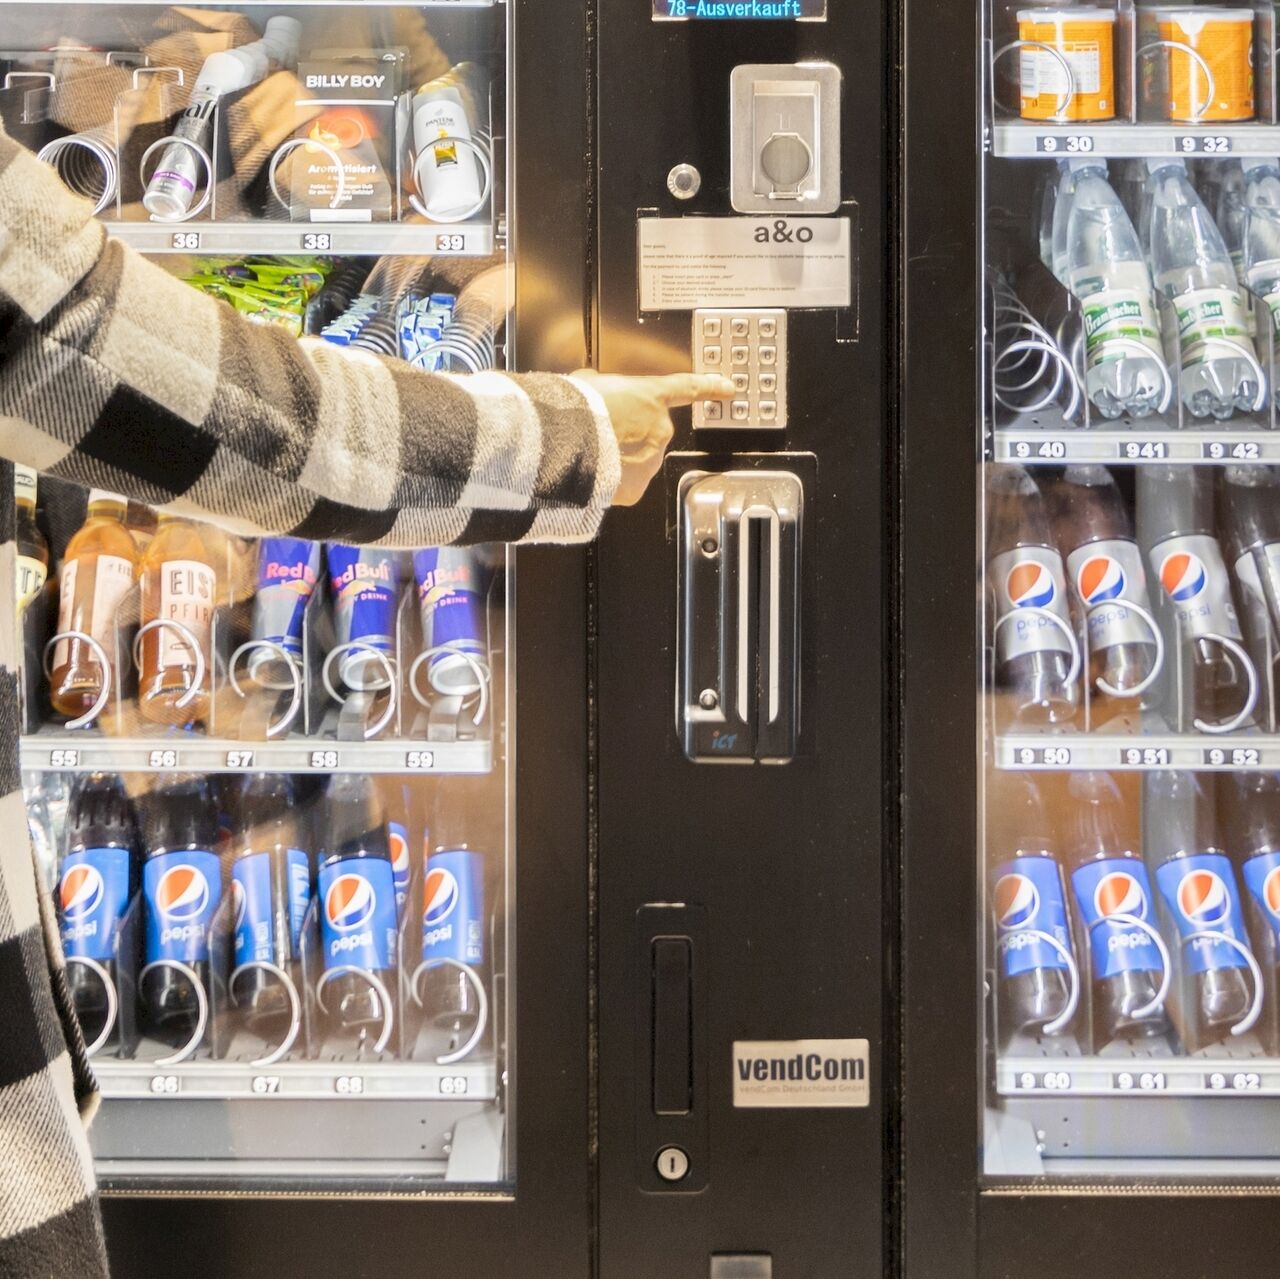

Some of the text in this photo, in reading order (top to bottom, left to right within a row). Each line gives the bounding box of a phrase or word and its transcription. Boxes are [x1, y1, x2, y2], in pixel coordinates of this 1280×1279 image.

[668, 0, 801, 16] 78-Ausverkauft
[306, 75, 385, 88] BILLY BOY
[308, 164, 377, 174] Aromtisiert
[754, 220, 813, 243] a&o
[173, 234, 198, 249] 36
[304, 234, 330, 250] 38
[438, 235, 464, 250] 39
[266, 562, 302, 579] Red
[355, 561, 390, 581] Bull
[1178, 604, 1210, 621] epsi
[1016, 615, 1058, 633] peps
[52, 752, 77, 766] 55
[150, 752, 176, 766] 56
[228, 752, 252, 766] 57
[312, 752, 338, 766] 58
[408, 752, 432, 766] 59
[160, 924, 204, 945] pepsi
[1108, 932, 1151, 952] pepsi
[331, 930, 373, 956] pepsi
[738, 1053, 864, 1081] vendCom
[152, 1078, 176, 1092] 66
[254, 1078, 278, 1092] 67
[337, 1078, 362, 1092] 68
[441, 1078, 466, 1092] 69
